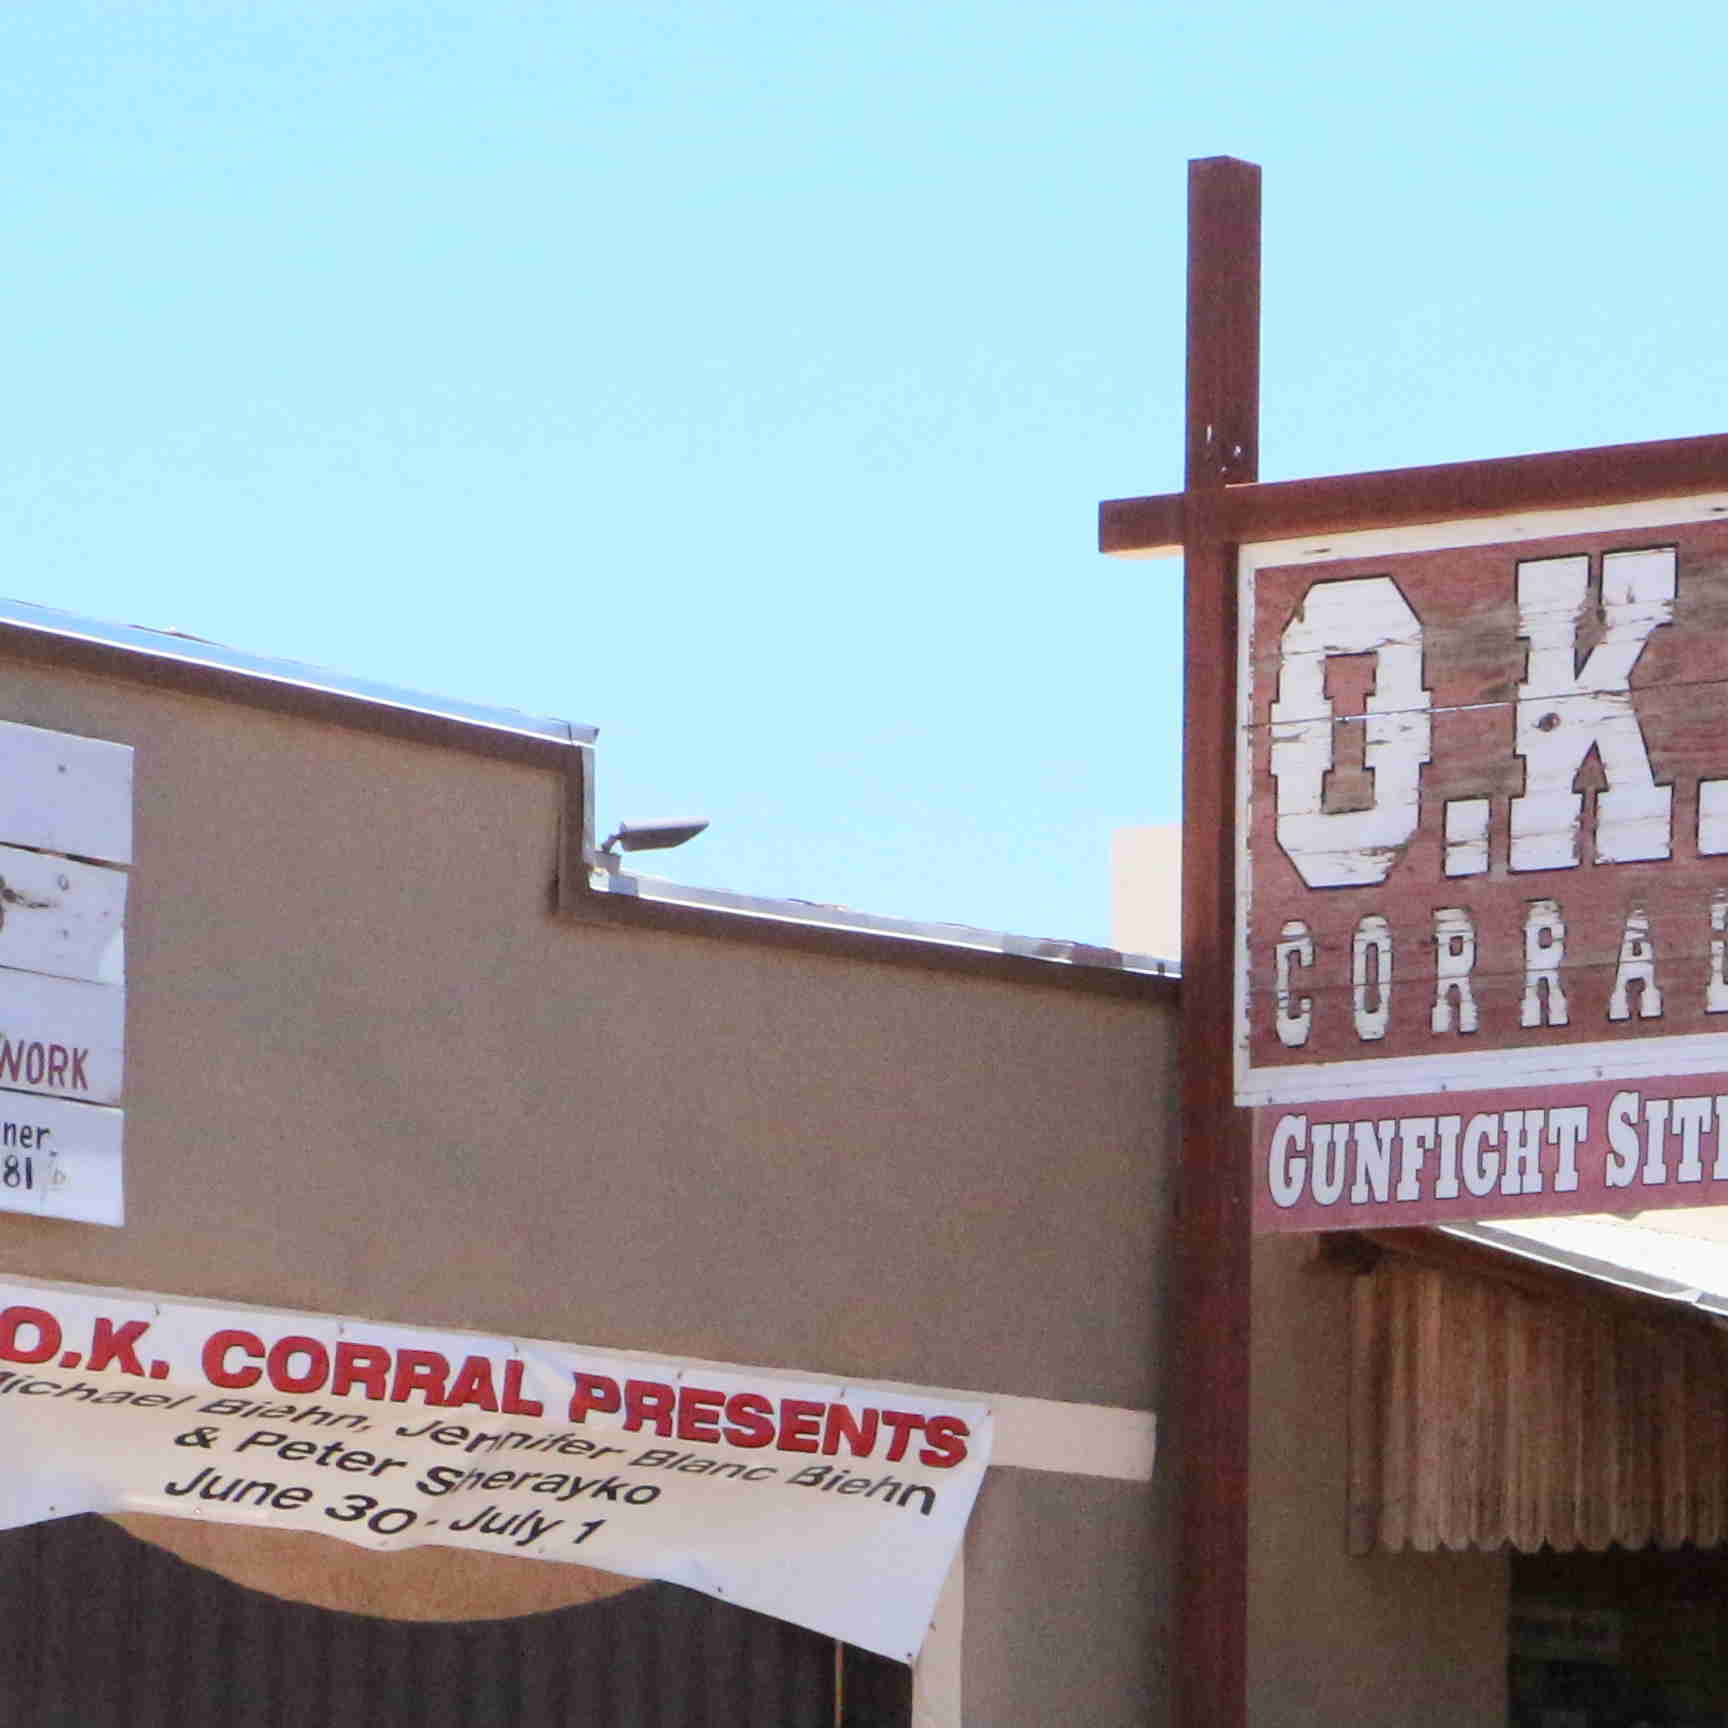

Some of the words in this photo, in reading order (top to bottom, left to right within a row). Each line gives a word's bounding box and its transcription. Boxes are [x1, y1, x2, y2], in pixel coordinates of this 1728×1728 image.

[1267, 1105, 1588, 1209] GUNFIGHT
[0, 1305, 170, 1380] O.K.
[201, 1329, 544, 1418] CORRAL
[568, 1371, 971, 1469] PRESENTS
[163, 1465, 316, 1512] June
[324, 1492, 418, 1536] 30
[448, 1503, 564, 1548] July
[572, 1517, 608, 1545] 1
[174, 1425, 223, 1450] &
[233, 1429, 408, 1479] Peter
[415, 1463, 662, 1508] Sherayko
[197, 1398, 374, 1434] Biehn,
[395, 1417, 628, 1461] Jennifer
[628, 1447, 777, 1484] Blanc
[785, 1464, 938, 1516] Biehn
